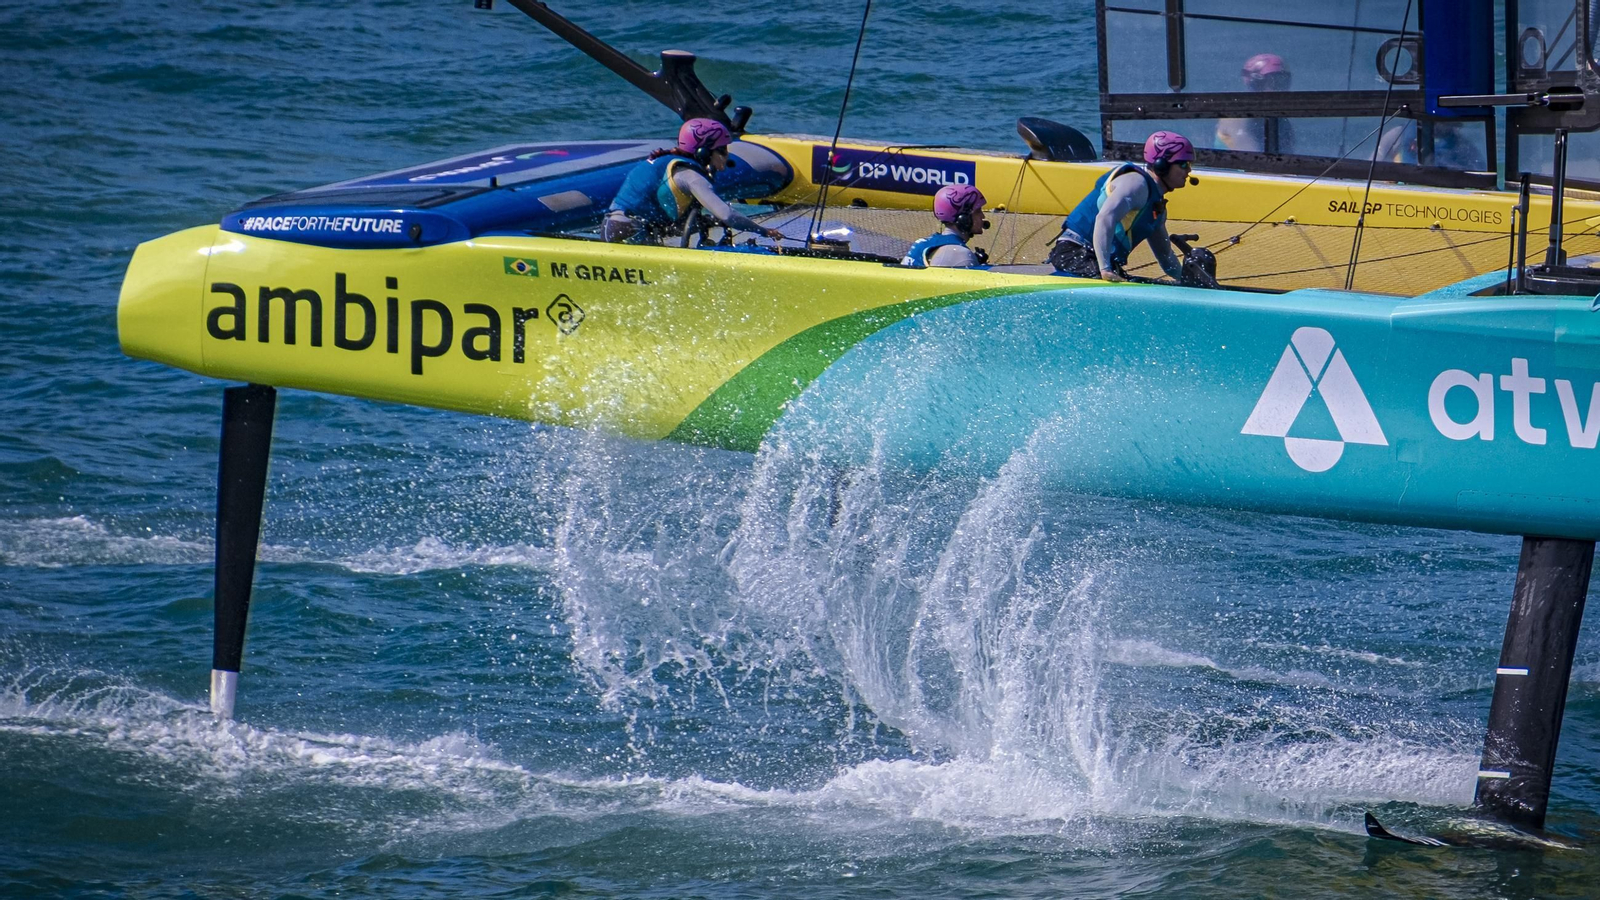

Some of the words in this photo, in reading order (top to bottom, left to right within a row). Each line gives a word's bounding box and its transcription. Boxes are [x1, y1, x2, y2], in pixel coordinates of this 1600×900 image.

[859, 162, 887, 179] DP
[891, 165, 969, 186] WORLD
[243, 216, 404, 233] #RACEFORTHEFUTURE
[1328, 200, 1382, 215] SAILGP
[1386, 203, 1502, 225] TECHNOLOGIES
[550, 262, 569, 279] M
[574, 264, 652, 286] GRAEL
[206, 272, 538, 375] ambipar
